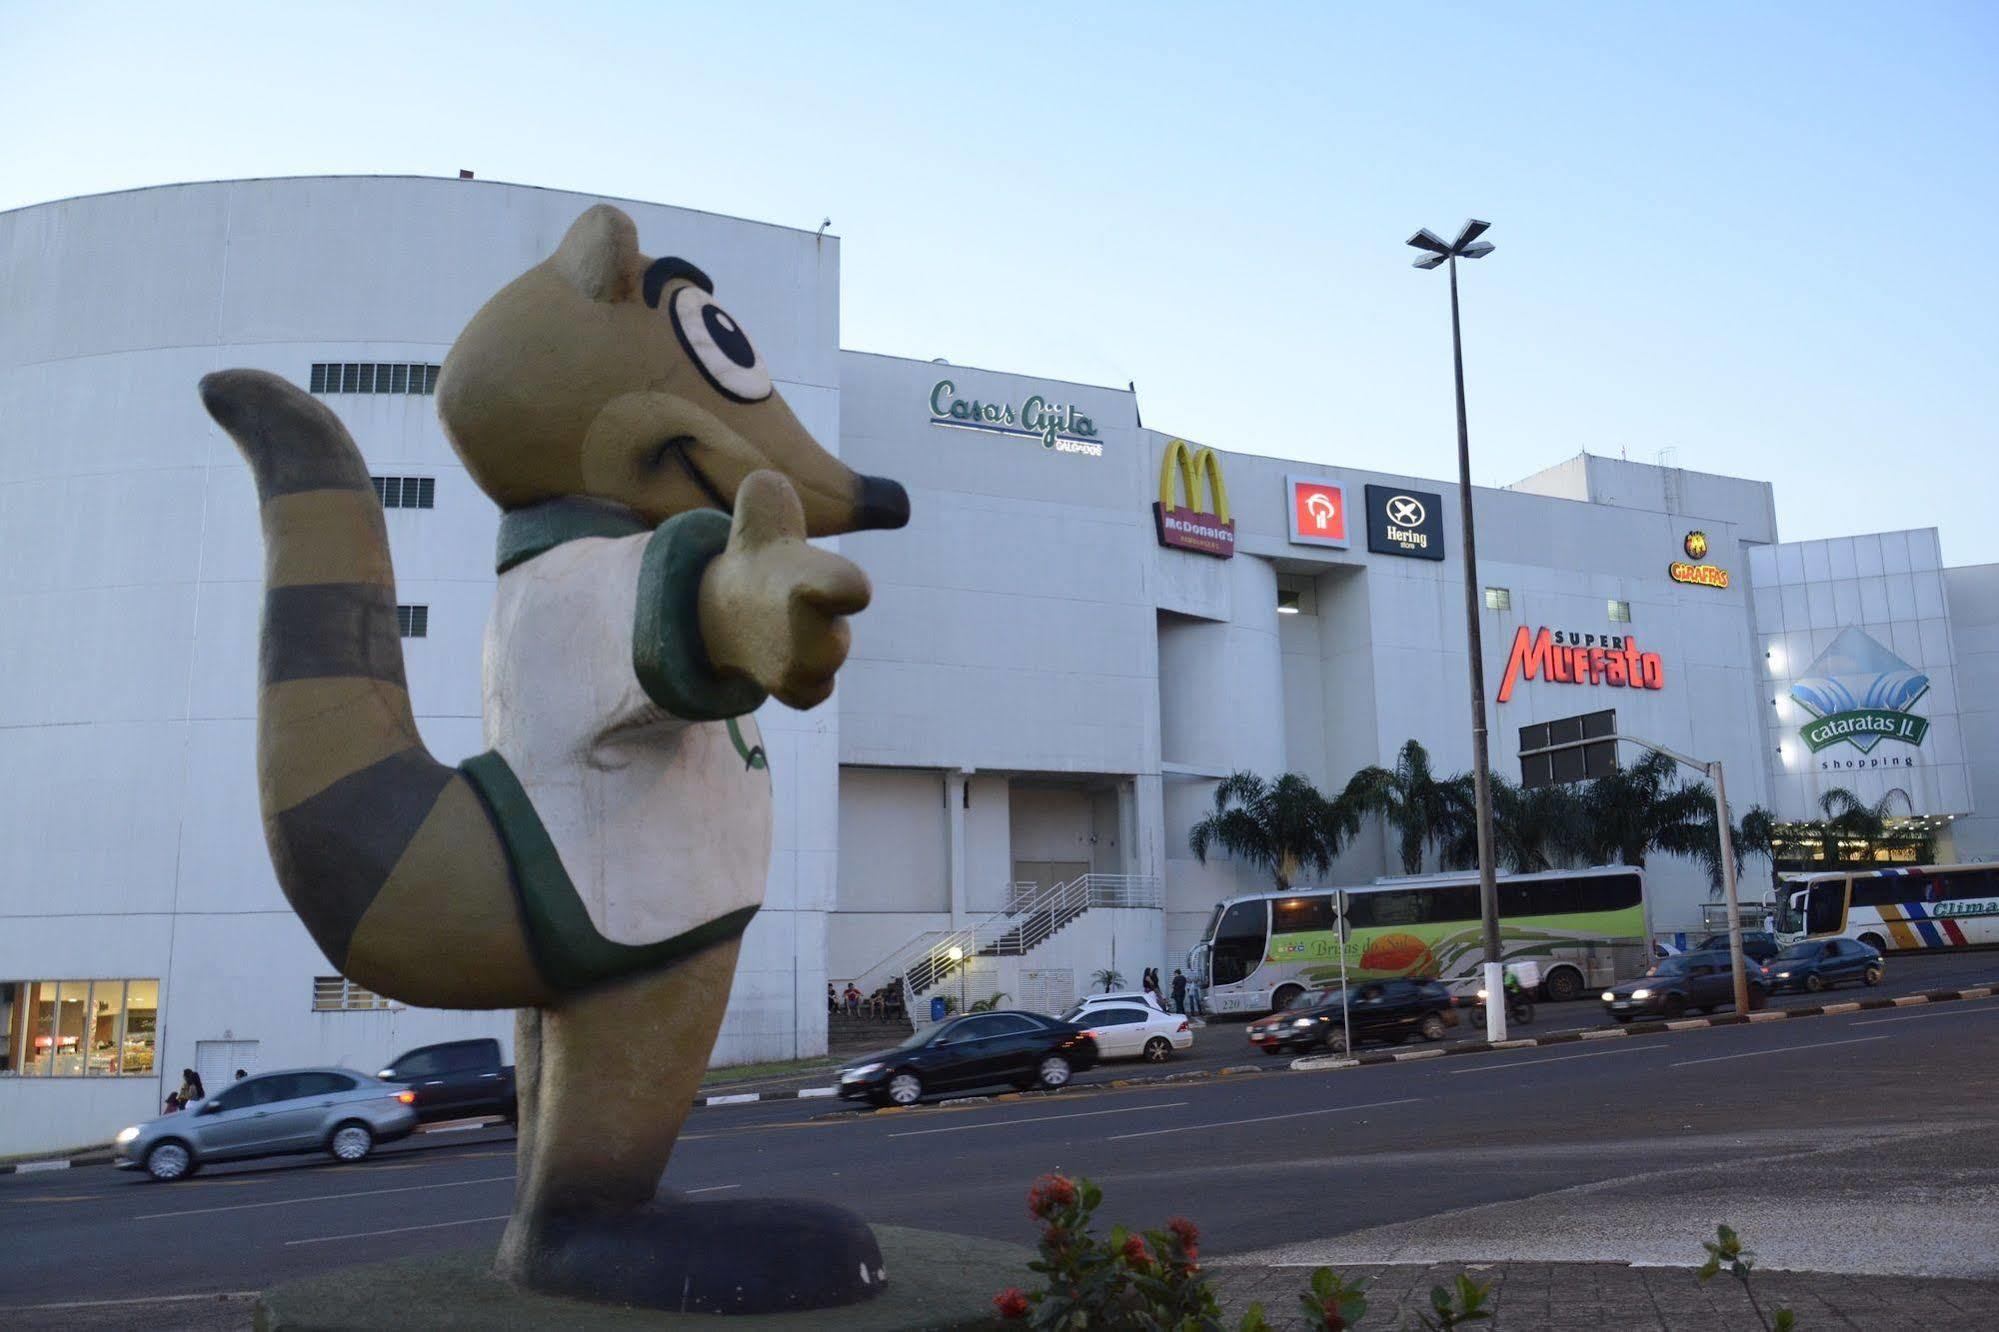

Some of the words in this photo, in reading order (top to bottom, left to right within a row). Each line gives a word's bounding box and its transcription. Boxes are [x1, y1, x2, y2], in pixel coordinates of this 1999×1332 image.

[930, 379, 1016, 426] Casas
[1165, 517, 1233, 542] McDonald's
[1387, 525, 1427, 548] Hering
[1554, 630, 1623, 649] SUPER
[1811, 714, 1895, 743] cataratas
[1822, 756, 1913, 769] shopping
[1222, 999, 1240, 1010] 220
